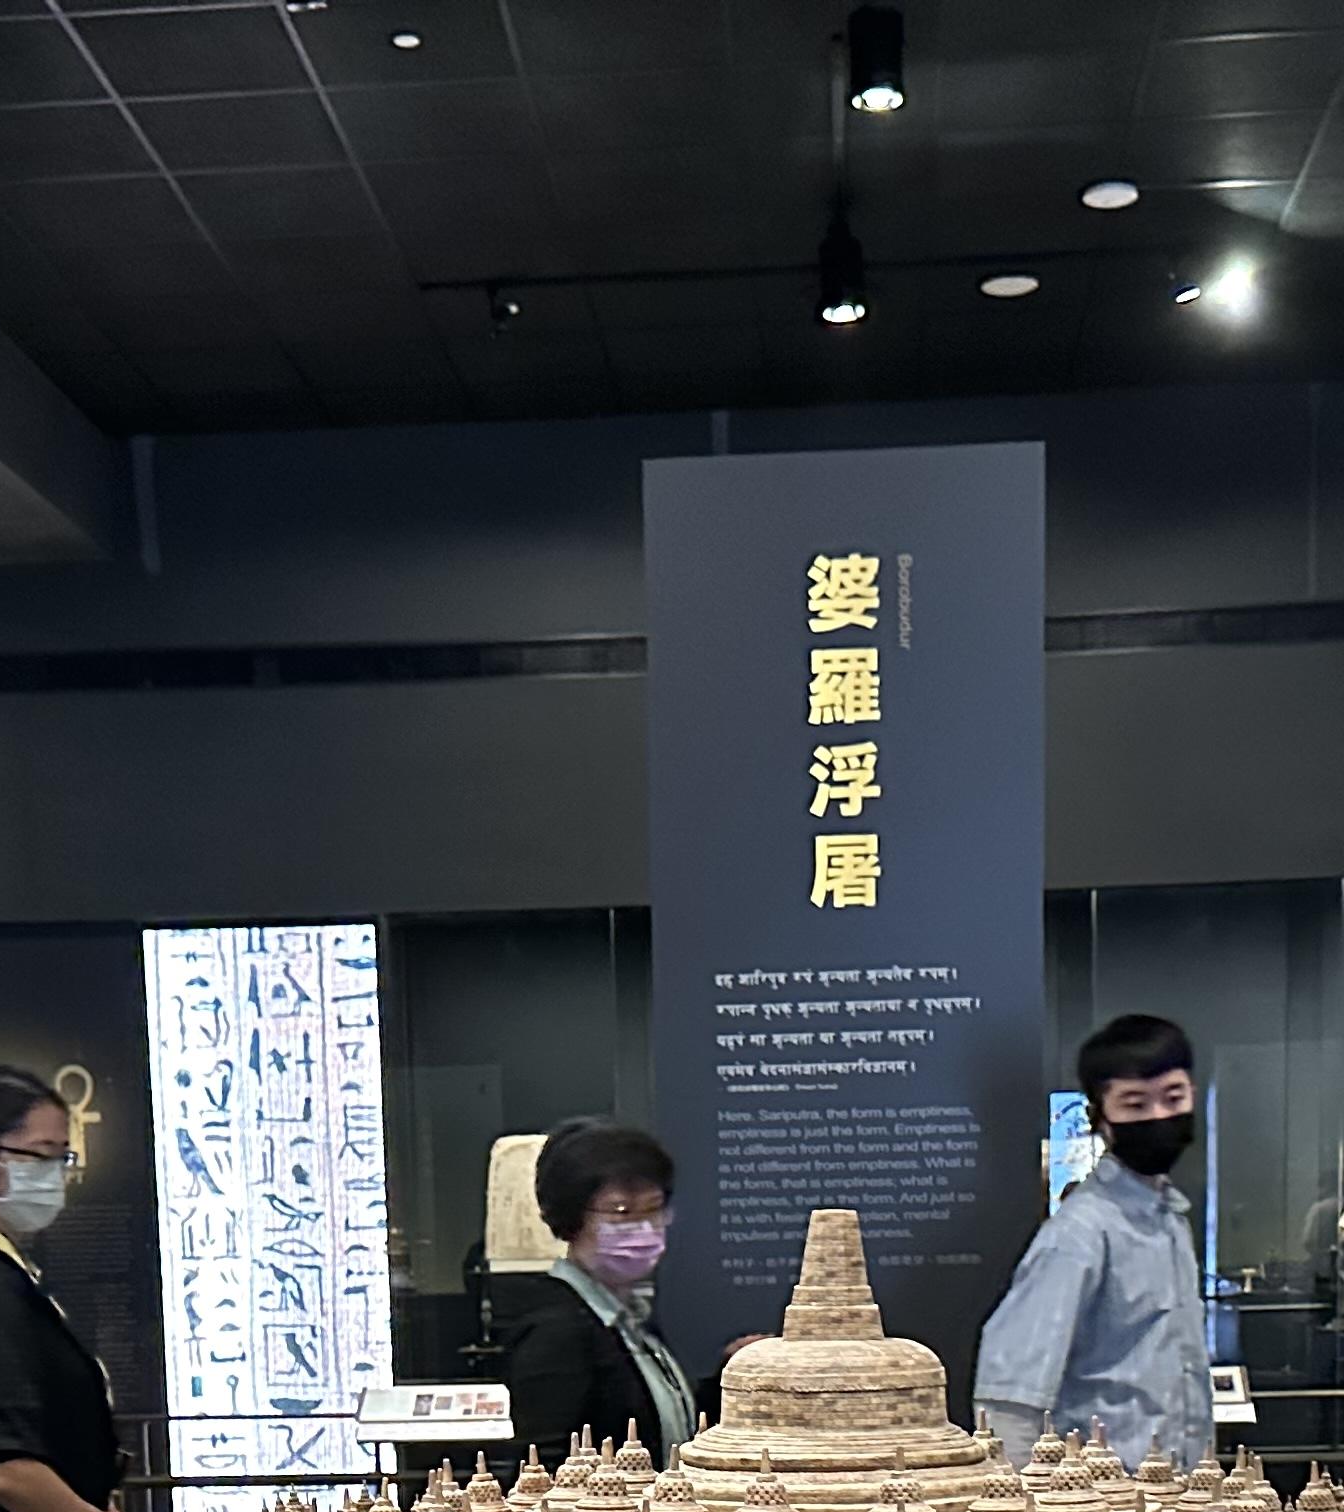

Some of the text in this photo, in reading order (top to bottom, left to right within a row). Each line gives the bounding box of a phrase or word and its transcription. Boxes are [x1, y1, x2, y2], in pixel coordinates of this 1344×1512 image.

[896, 553, 913, 650] Borobudur
[807, 553, 882, 908] 婆羅浮屠
[826, 1108, 849, 1119] the
[851, 1107, 883, 1118] form
[885, 1107, 897, 1118] is
[718, 1128, 787, 1140] emptiness
[790, 1127, 802, 1137] is
[803, 1126, 828, 1139] just
[831, 1126, 854, 1136] the
[894, 1123, 966, 1136] Emptiness
[968, 1122, 981, 1132] is
[719, 1139, 978, 1155] not different from the form and the form
[718, 1163, 731, 1173] is
[734, 1161, 755, 1173] not
[757, 1161, 811, 1172] different
[814, 1160, 845, 1171] from
[923, 1157, 961, 1168] What
[964, 1157, 976, 1167] is
[719, 1179, 741, 1190] the
[781, 1178, 806, 1188] that
[809, 1178, 821, 1188] is
[900, 1175, 933, 1186] what
[936, 1175, 948, 1185] is
[794, 1195, 821, 1206] that
[823, 1196, 835, 1205] is
[837, 1194, 860, 1205] the
[900, 1192, 927, 1203] And
[929, 1192, 954, 1206] just
[958, 1193, 975, 1203] so
[731, 1213, 743, 1224] is
[745, 1212, 773, 1223] with
[903, 1208, 950, 1220] mental
